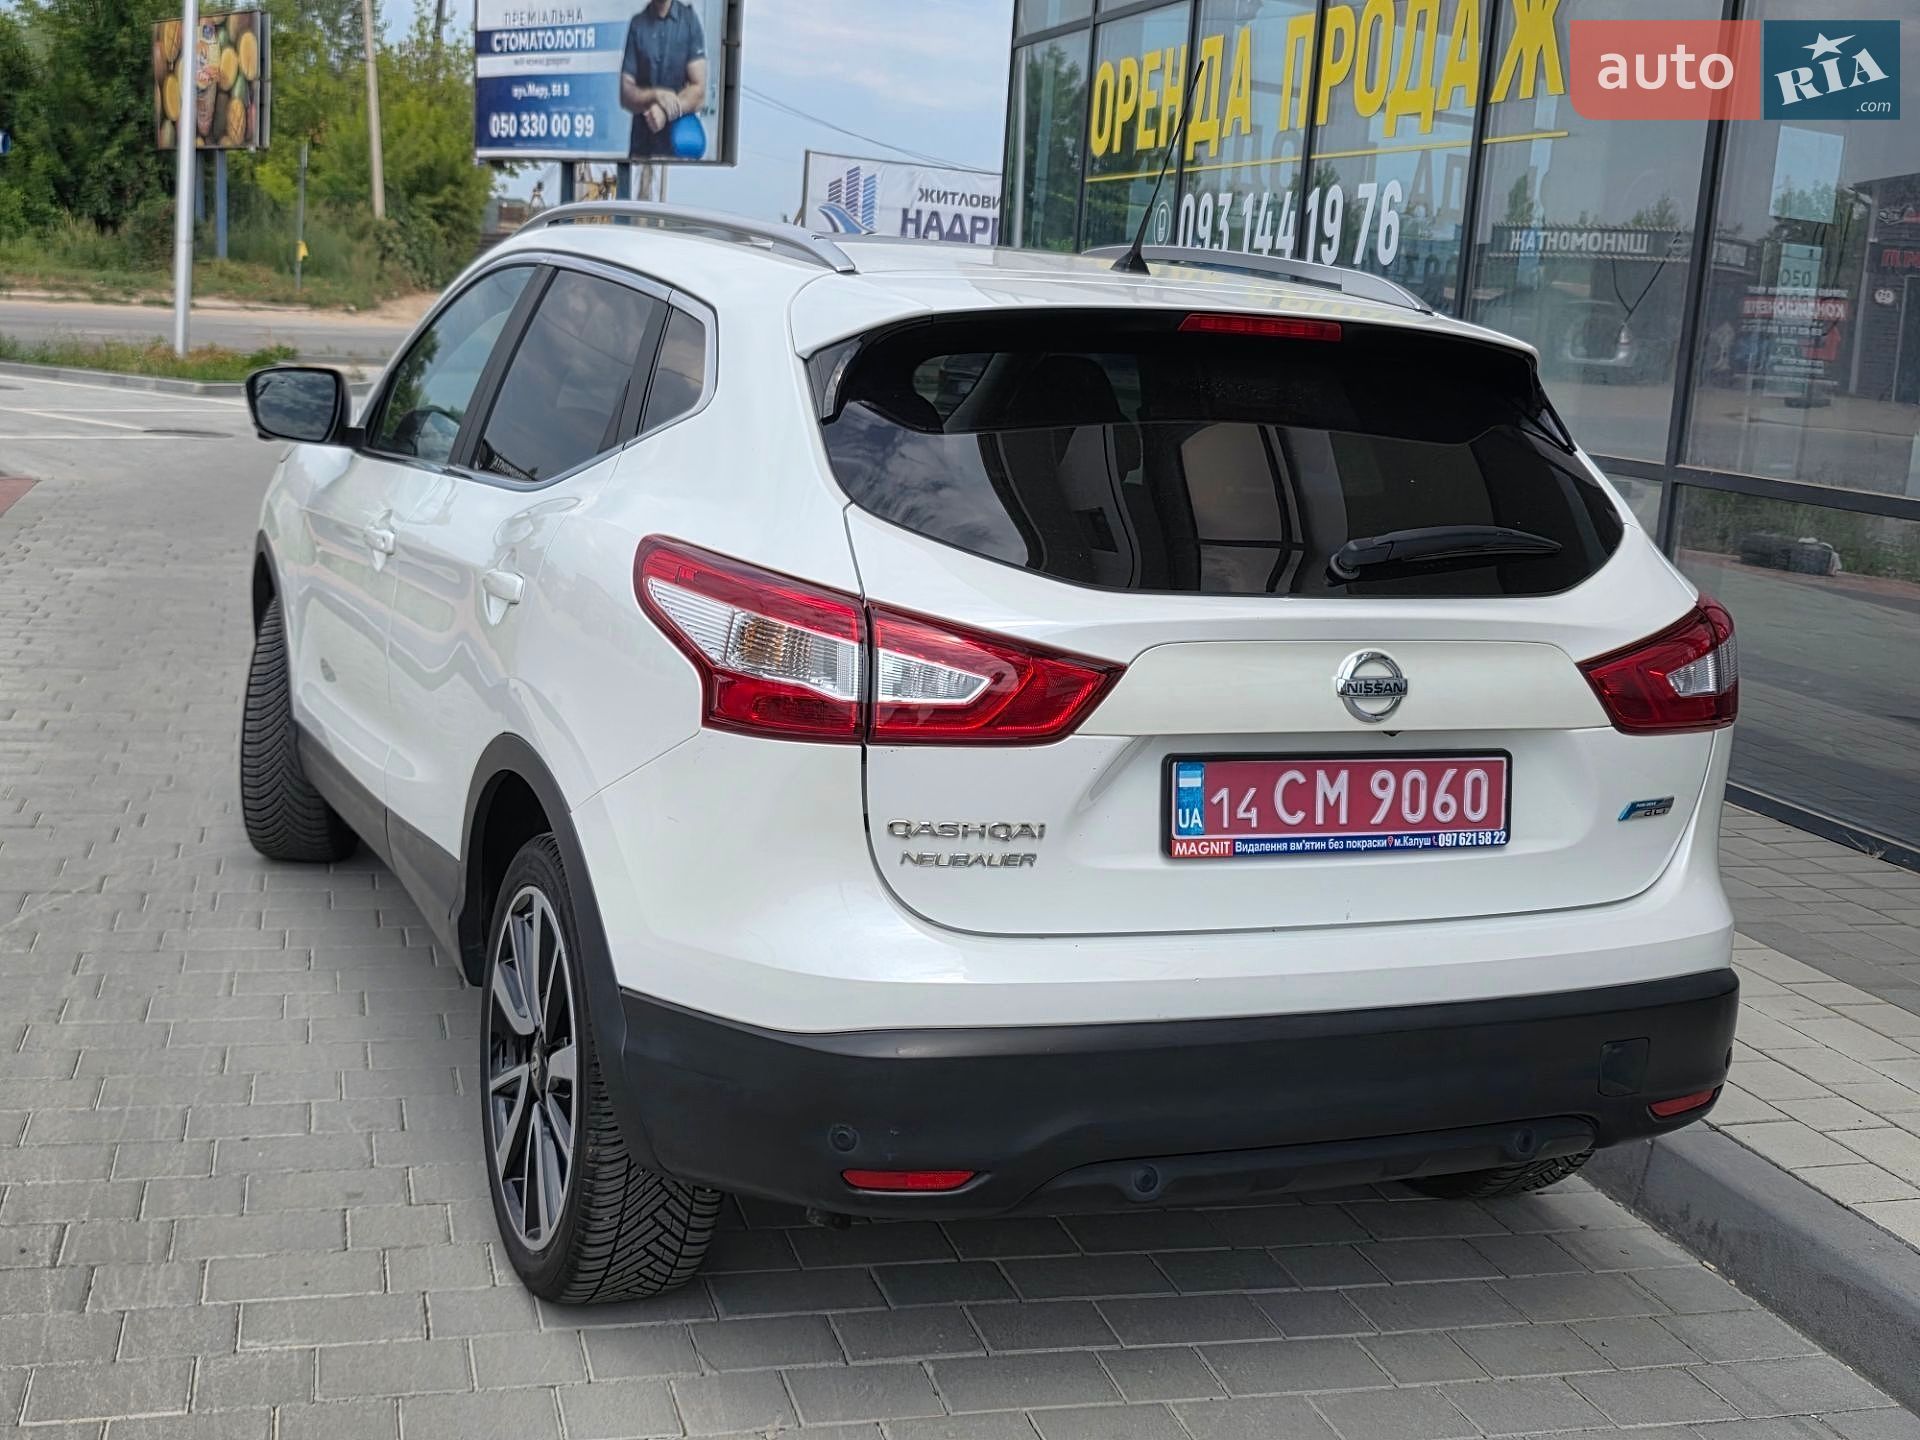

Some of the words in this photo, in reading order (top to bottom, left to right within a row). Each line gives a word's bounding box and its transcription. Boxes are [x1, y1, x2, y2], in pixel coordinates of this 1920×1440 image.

[504, 7, 583, 26] ПРЕМІАЛЬНА
[492, 27, 595, 52] СТОМАТОЛОГІЯ
[1090, 27, 1253, 161] ОРЕНДА
[1279, 0, 1566, 138] ПРОДАЖ
[489, 112, 517, 138] 050
[519, 112, 547, 138] 330
[551, 112, 571, 138] 00
[574, 113, 594, 138] 99
[1177, 193, 1233, 250] 093
[1242, 190, 1297, 260] 144
[1305, 184, 1345, 266] 19
[1353, 180, 1403, 266] 76
[1346, 682, 1403, 694] NISSAN
[1211, 787, 1258, 829] 14
[1273, 769, 1349, 826] CM
[1369, 768, 1489, 826] 9060
[887, 818, 1047, 842] QASHQAI
[1178, 807, 1203, 830] UA
[1175, 842, 1230, 855] MAGNIT
[1235, 841, 1287, 854] Видалення
[1327, 838, 1344, 850] без
[1345, 837, 1387, 853] покраски
[1394, 836, 1431, 849] м.Калуш
[1438, 832, 1457, 847] 097
[1459, 832, 1477, 846] 621
[1478, 831, 1492, 845] 58
[1493, 830, 1506, 844] 22
[900, 851, 1038, 868] NEUBAUER
